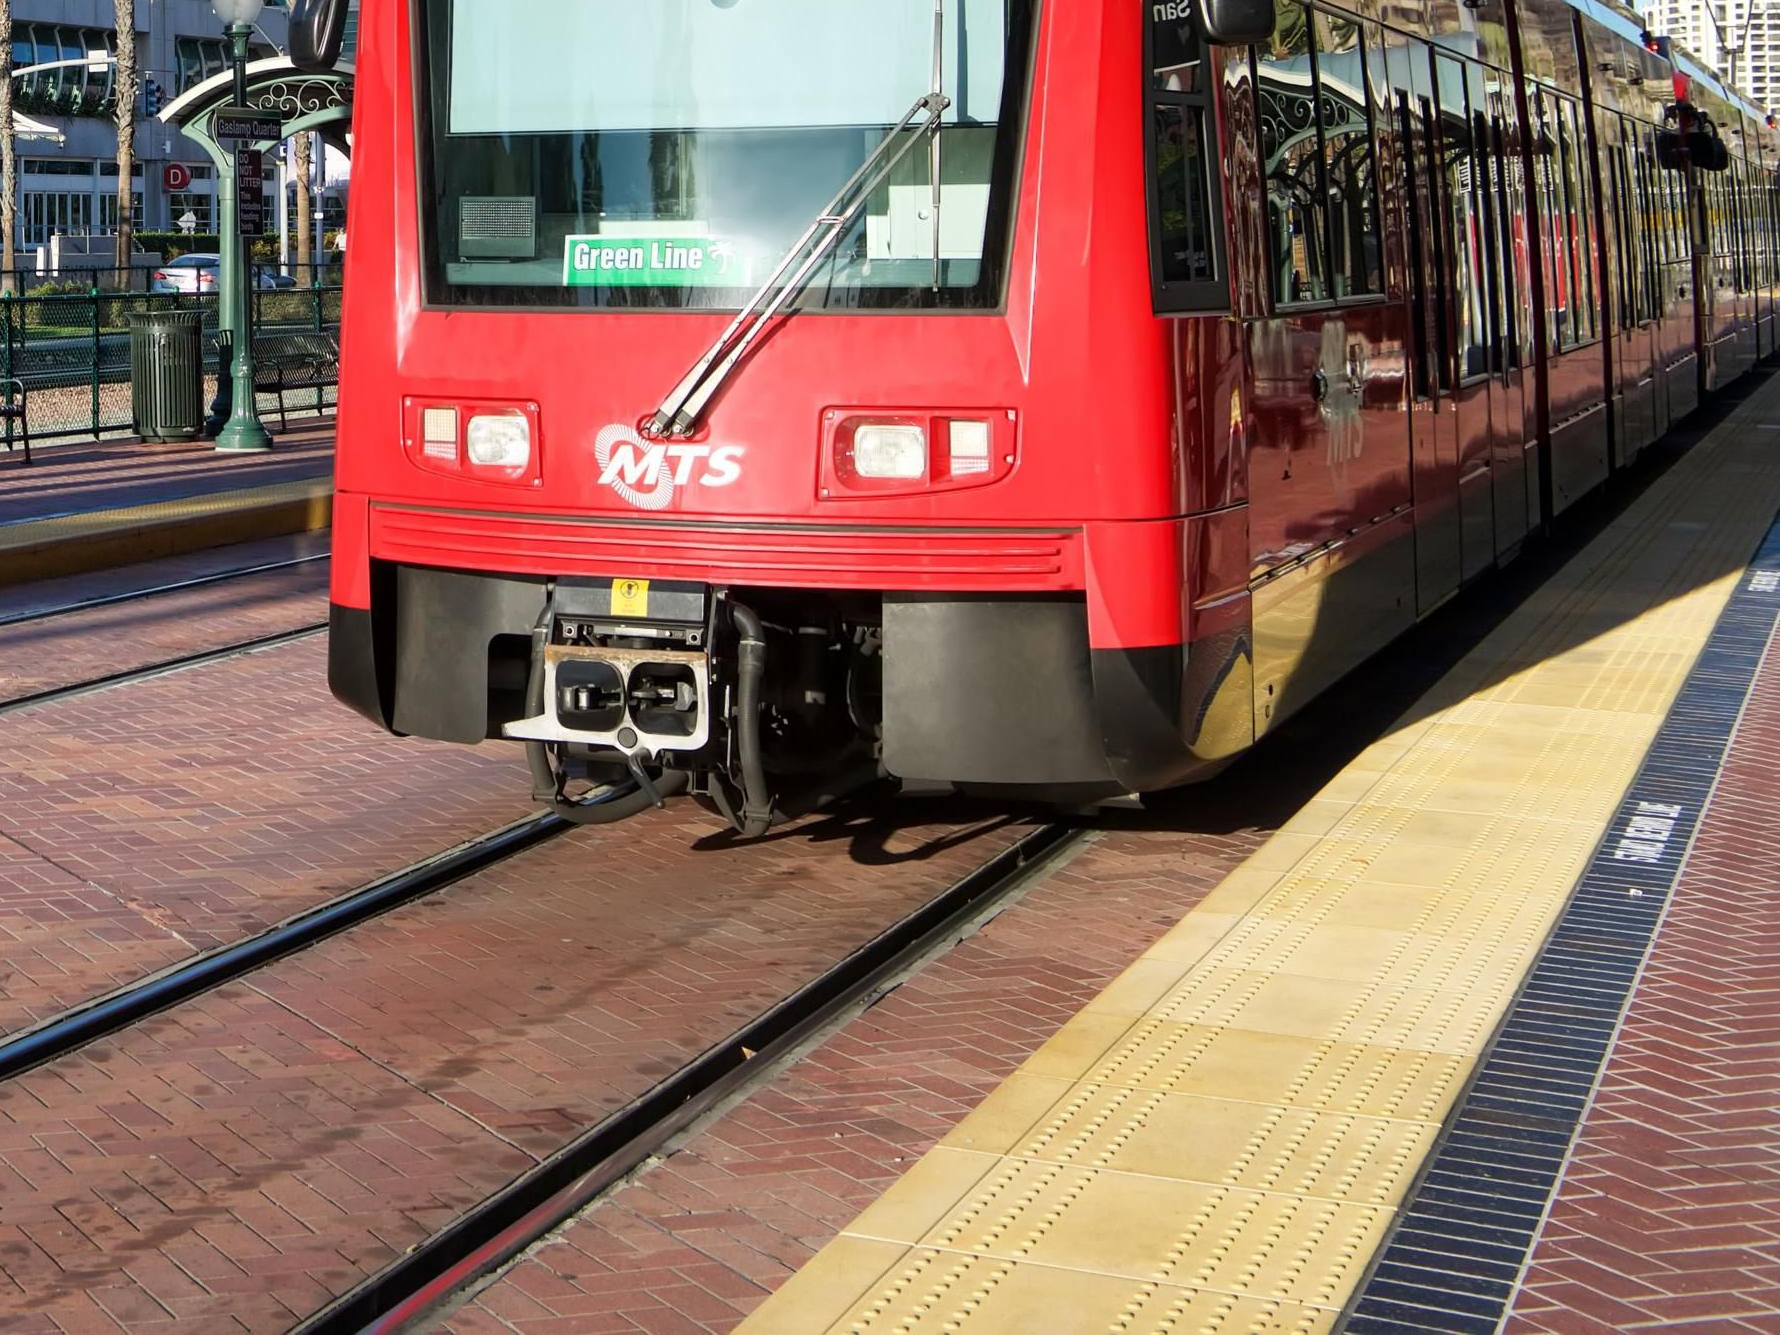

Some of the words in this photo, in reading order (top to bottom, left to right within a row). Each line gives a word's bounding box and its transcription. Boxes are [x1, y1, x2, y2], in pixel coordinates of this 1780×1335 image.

[218, 119, 251, 137] Gaslamp
[253, 121, 280, 136] Quarter
[239, 153, 249, 164] DO
[171, 169, 181, 184] D
[239, 165, 253, 176] NOT
[239, 177, 261, 188] LITTER
[574, 242, 644, 270] Green
[650, 242, 703, 270] Line
[597, 444, 746, 487] MTS
